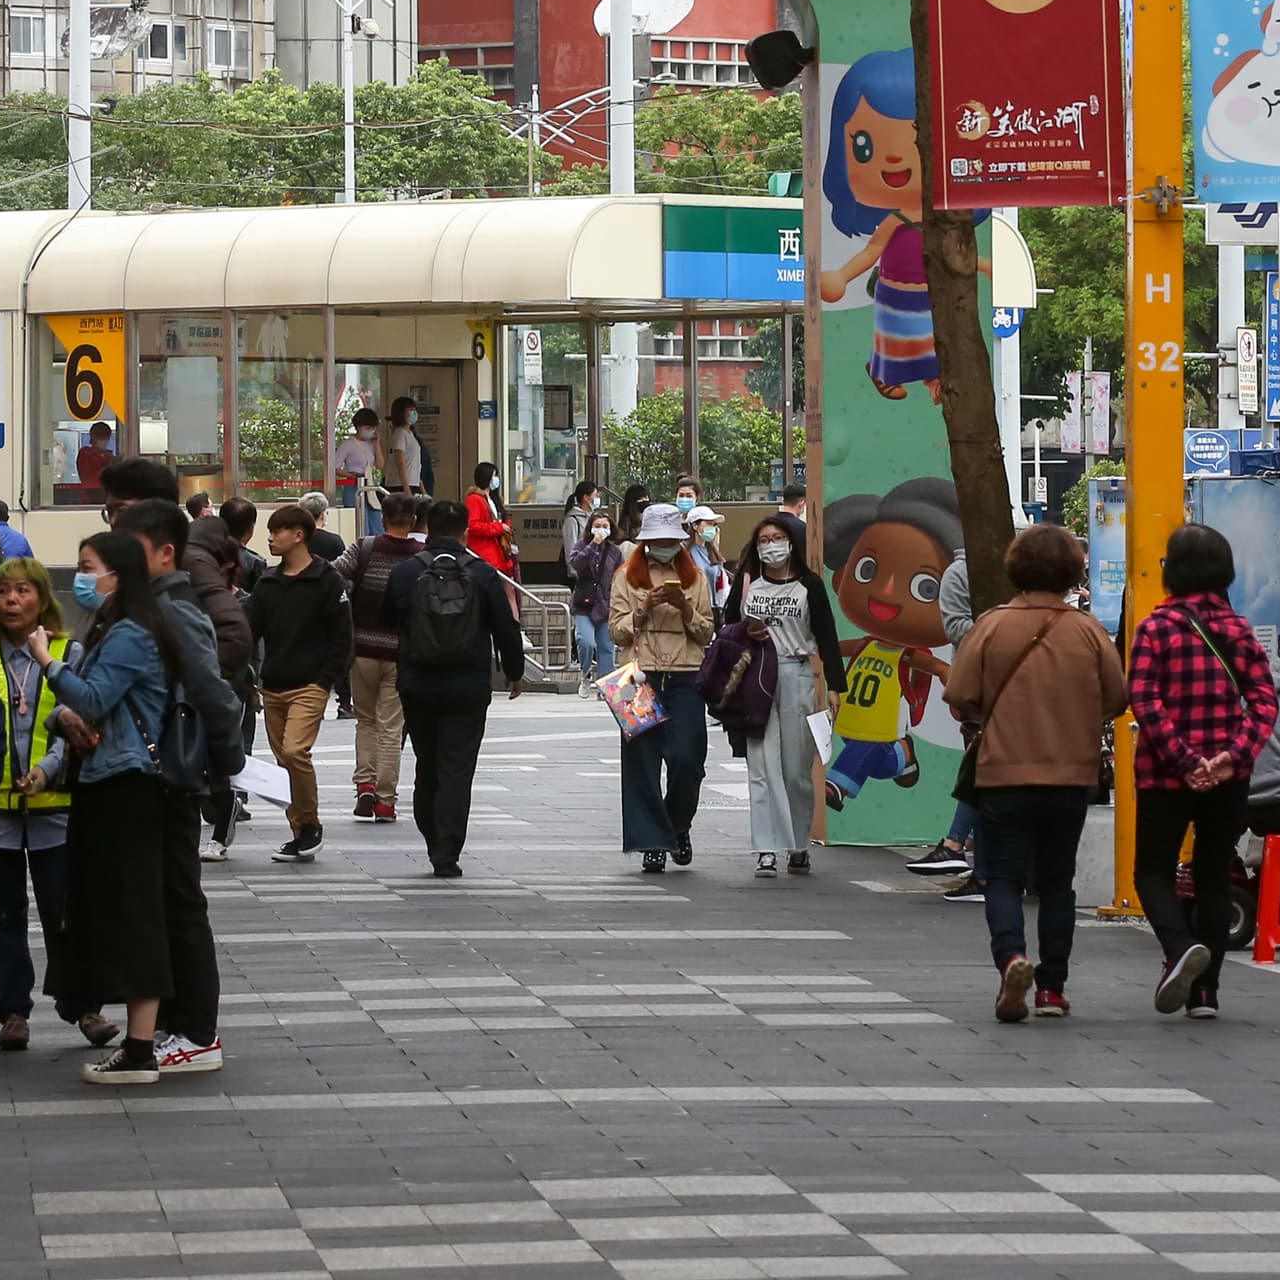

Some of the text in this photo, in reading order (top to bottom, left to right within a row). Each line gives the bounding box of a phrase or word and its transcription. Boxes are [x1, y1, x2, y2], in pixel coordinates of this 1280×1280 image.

[777, 227, 801, 262] 西
[1145, 273, 1171, 304] H
[472, 332, 486, 361] 6
[1137, 341, 1181, 374] 32
[64, 343, 105, 422] 6
[846, 671, 881, 708] 10
